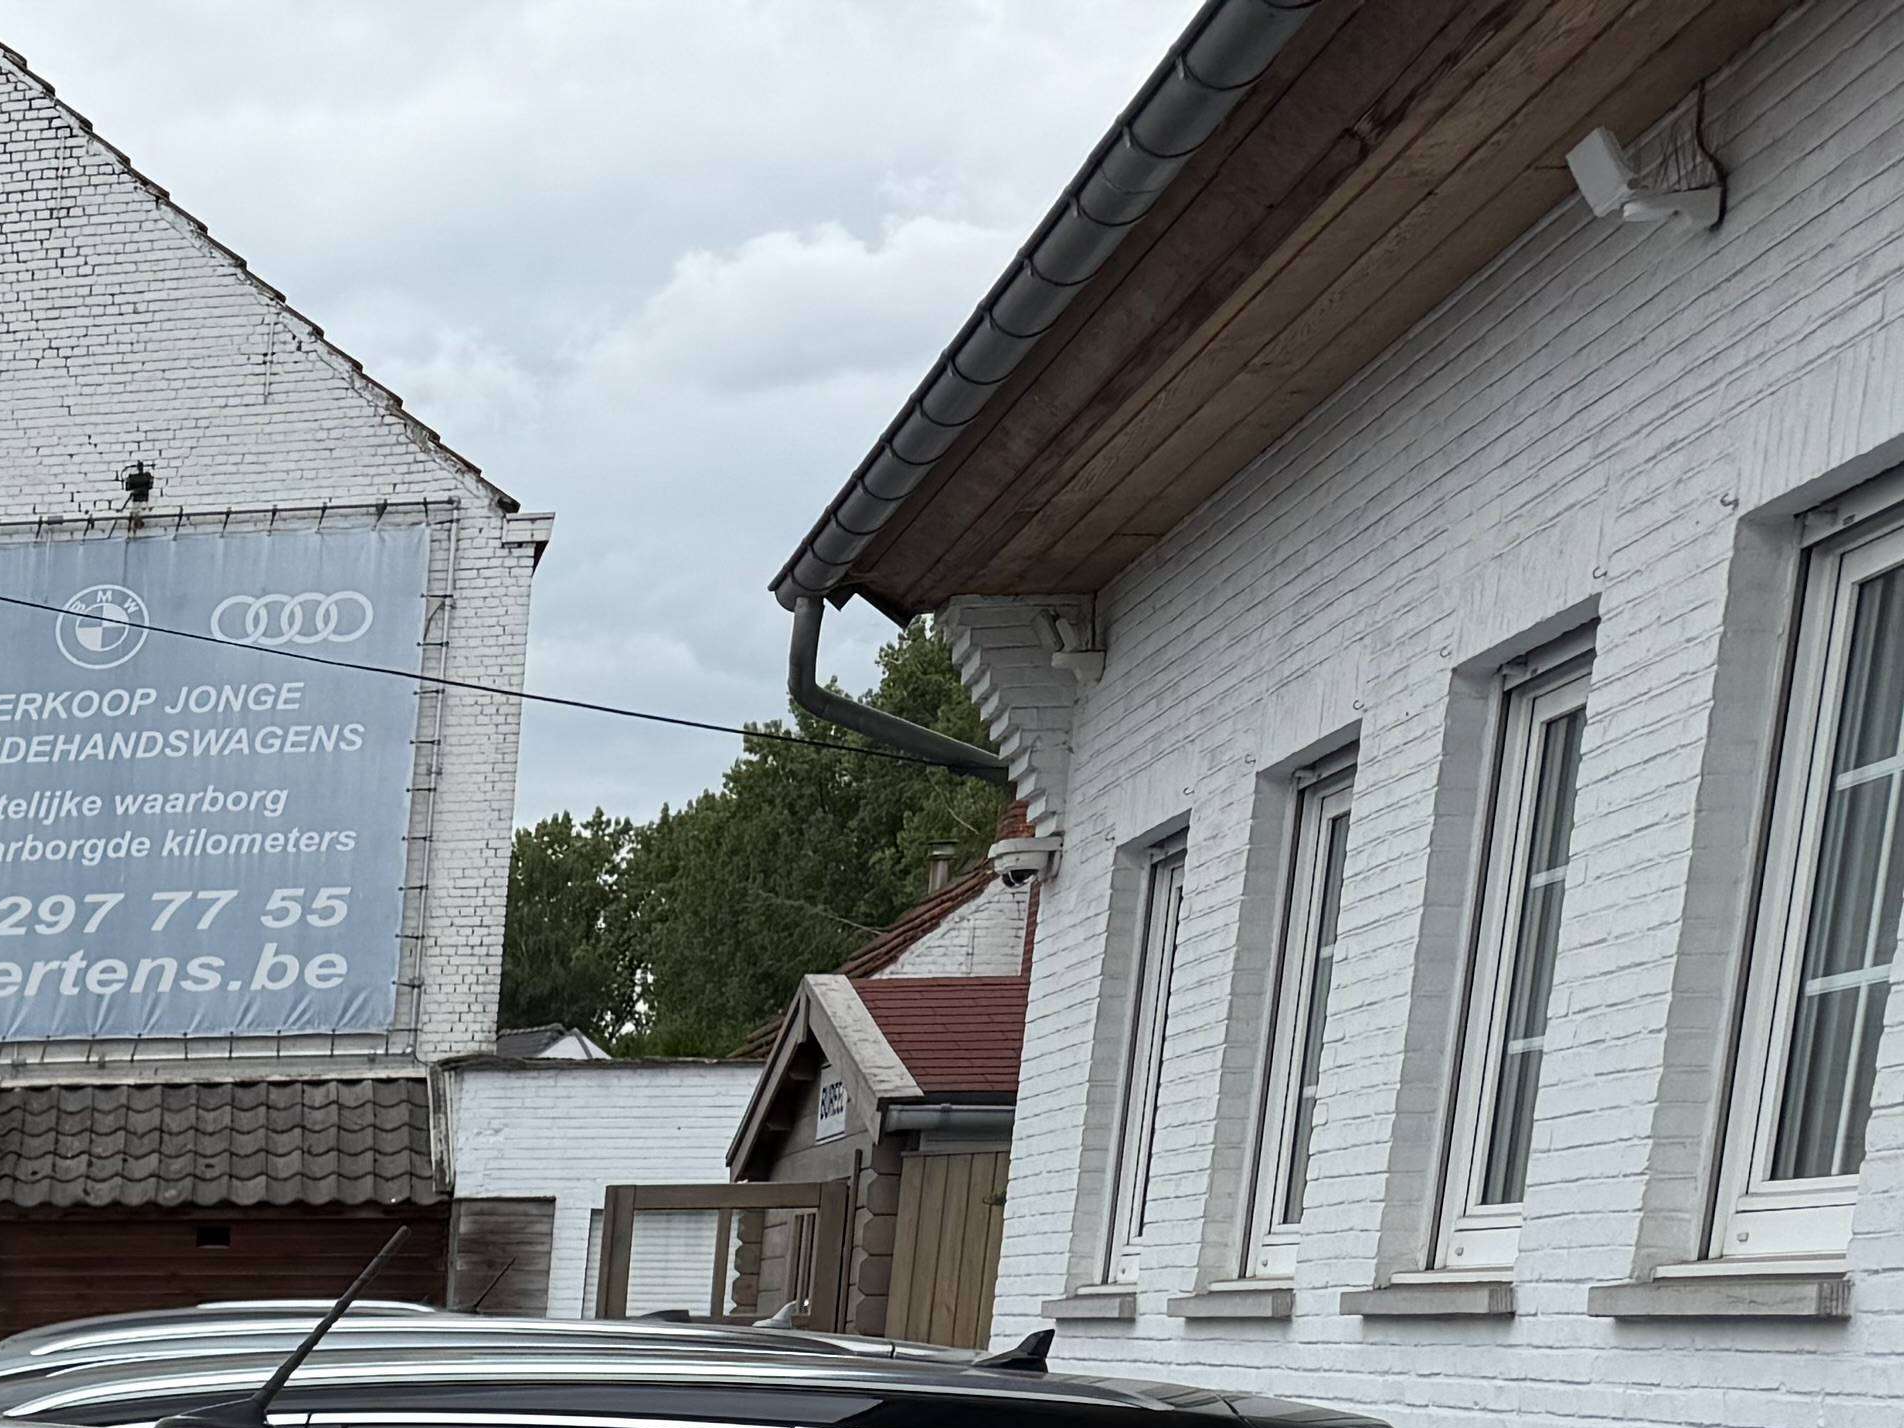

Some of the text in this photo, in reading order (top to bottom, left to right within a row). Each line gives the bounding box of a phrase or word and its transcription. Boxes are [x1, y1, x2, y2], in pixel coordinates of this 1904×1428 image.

[164, 681, 305, 714] JONGE
[114, 785, 289, 817] waarborg
[161, 826, 358, 859] kilometers
[149, 888, 239, 931] 77
[259, 886, 352, 929] 55
